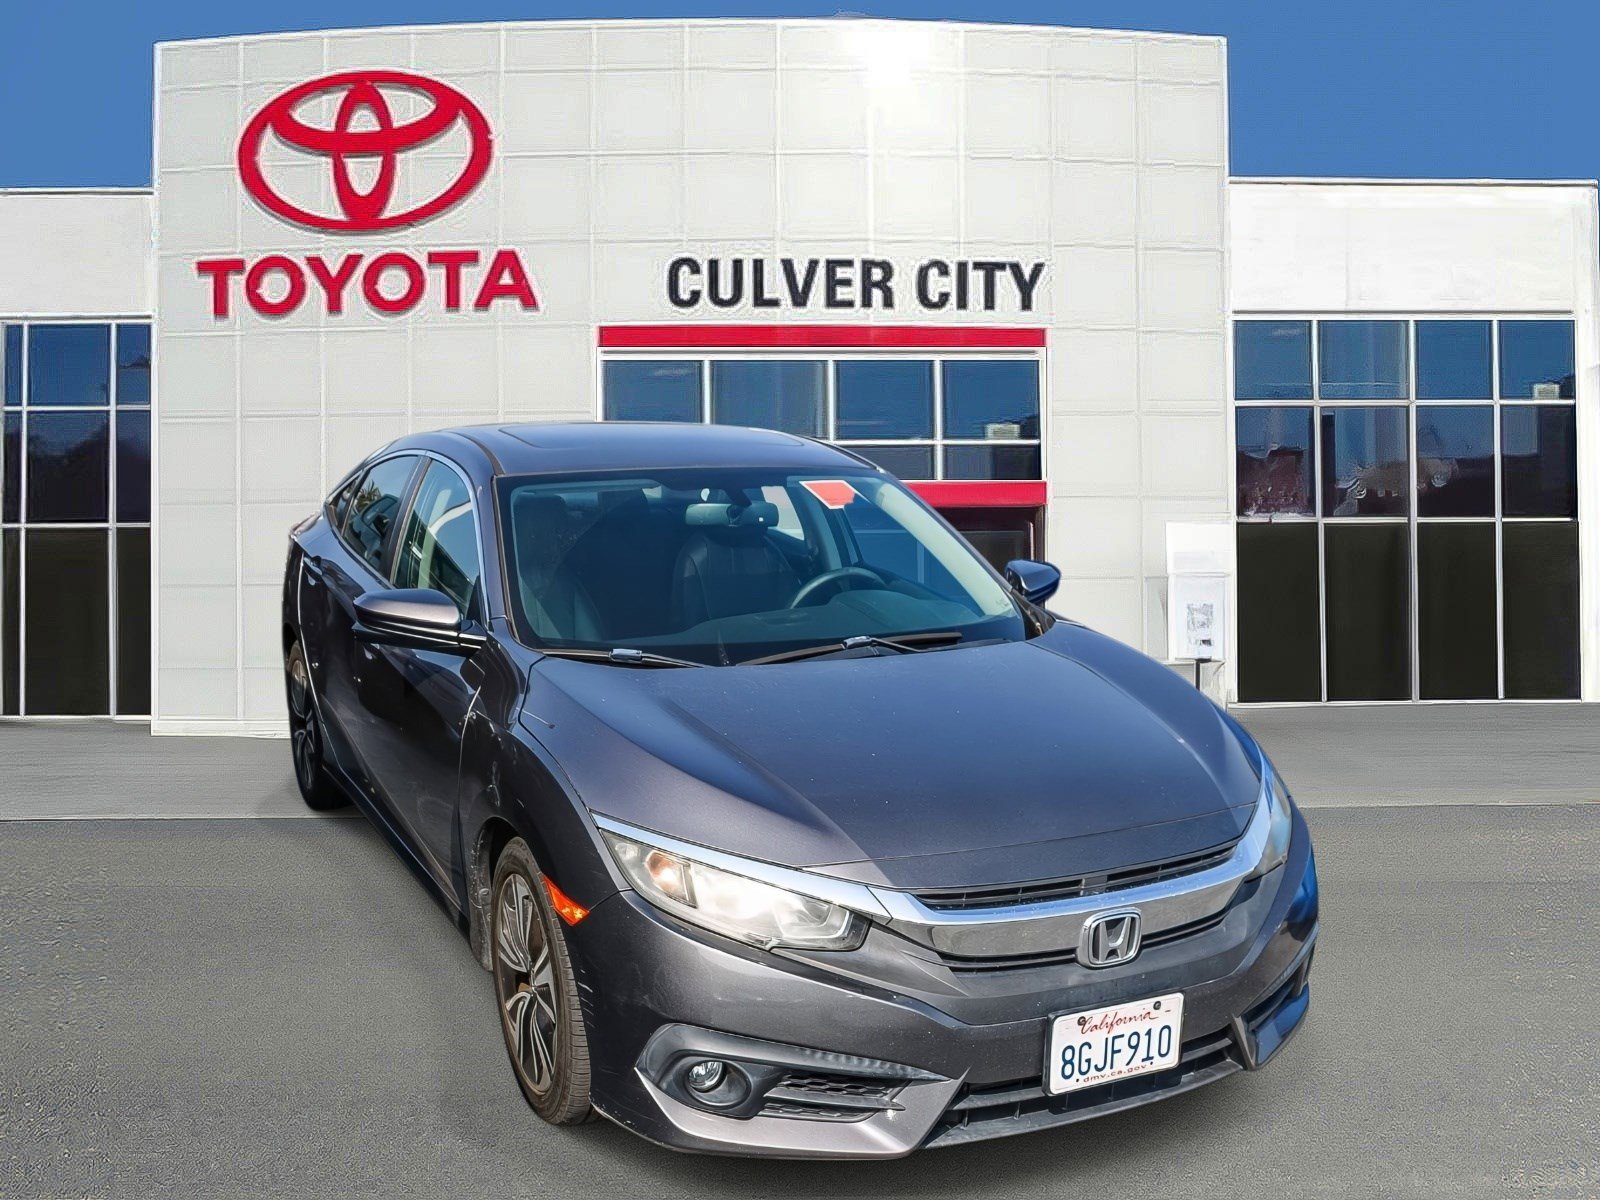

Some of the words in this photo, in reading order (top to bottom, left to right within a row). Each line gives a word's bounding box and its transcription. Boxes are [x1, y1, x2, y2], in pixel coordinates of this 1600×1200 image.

[196, 249, 539, 318] TOYOTA
[668, 257, 895, 309] CULVER
[917, 259, 1045, 310] CITY
[1081, 1009, 1158, 1034] California
[1061, 1025, 1171, 1079] 8GJF910
[1083, 1065, 1147, 1083] dmv.ca.gov
